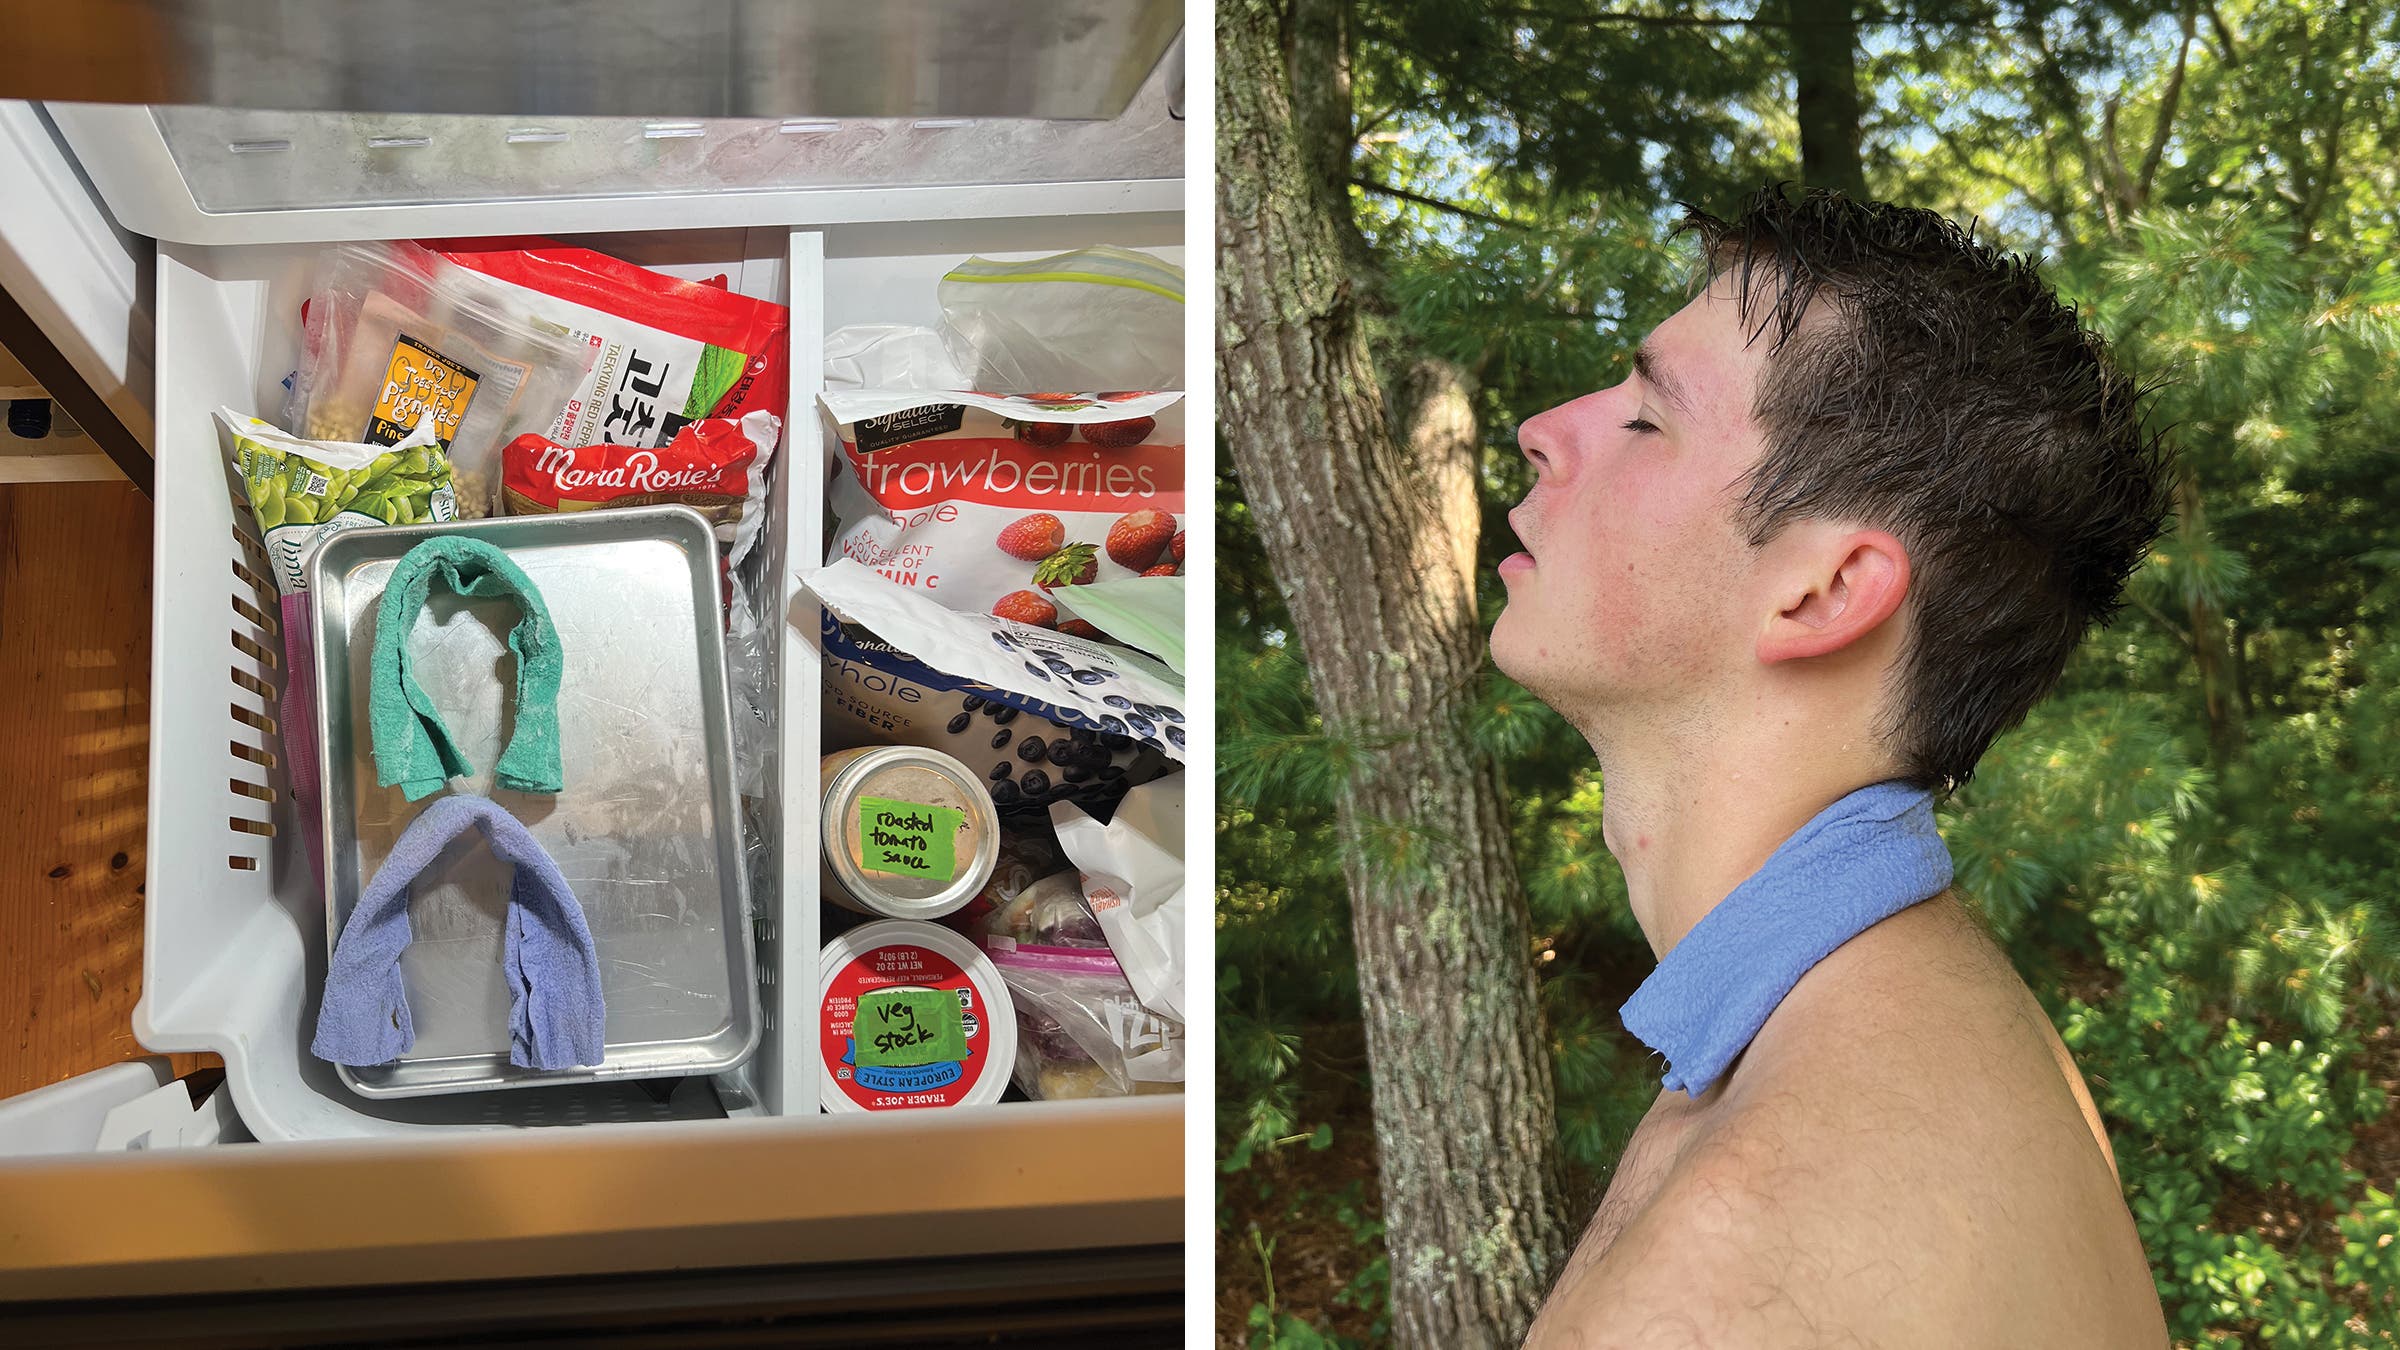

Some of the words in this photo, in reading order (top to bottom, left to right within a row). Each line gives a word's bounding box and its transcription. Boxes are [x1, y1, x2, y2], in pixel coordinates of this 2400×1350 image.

[414, 341, 441, 360] TRADER
[441, 358, 462, 371] JOE'S
[424, 358, 447, 384] Dry
[594, 344, 621, 399] TAEKYUNG
[404, 365, 461, 401] Toasted
[587, 399, 603, 419] RED
[604, 348, 671, 448] 고춧
[376, 420, 405, 440] Pine
[893, 412, 945, 431] SELECT
[576, 420, 595, 448] PEPPE
[870, 436, 900, 448] QUALITY
[902, 424, 949, 440] GUARANTEED
[625, 451, 724, 492] Rosie's
[889, 504, 958, 532] hole
[853, 535, 896, 567] SOURCE
[903, 557, 923, 569] OF
[862, 530, 933, 558] EXCELLENT
[282, 538, 307, 589] lima
[926, 575, 939, 588] C
[837, 697, 895, 731] FIBER
[849, 695, 912, 728] SOURCE
[877, 811, 934, 833] roasted
[869, 826, 927, 851] tomato
[882, 850, 931, 869] sauce
[876, 963, 886, 972] OZ
[879, 952, 897, 961] 907g
[886, 963, 896, 971] 32
[898, 951, 909, 961] LB)
[910, 951, 918, 961] (2
[911, 961, 923, 970] NET
[858, 976, 895, 984] REFRIGERATED
[877, 1002, 915, 1031] veg
[874, 1023, 934, 1054] stock
[863, 1073, 895, 1087] STYLE
[899, 1067, 956, 1088] EUROPEAN
[876, 1096, 904, 1106] JOE'S
[907, 1093, 945, 1105] TRADER
